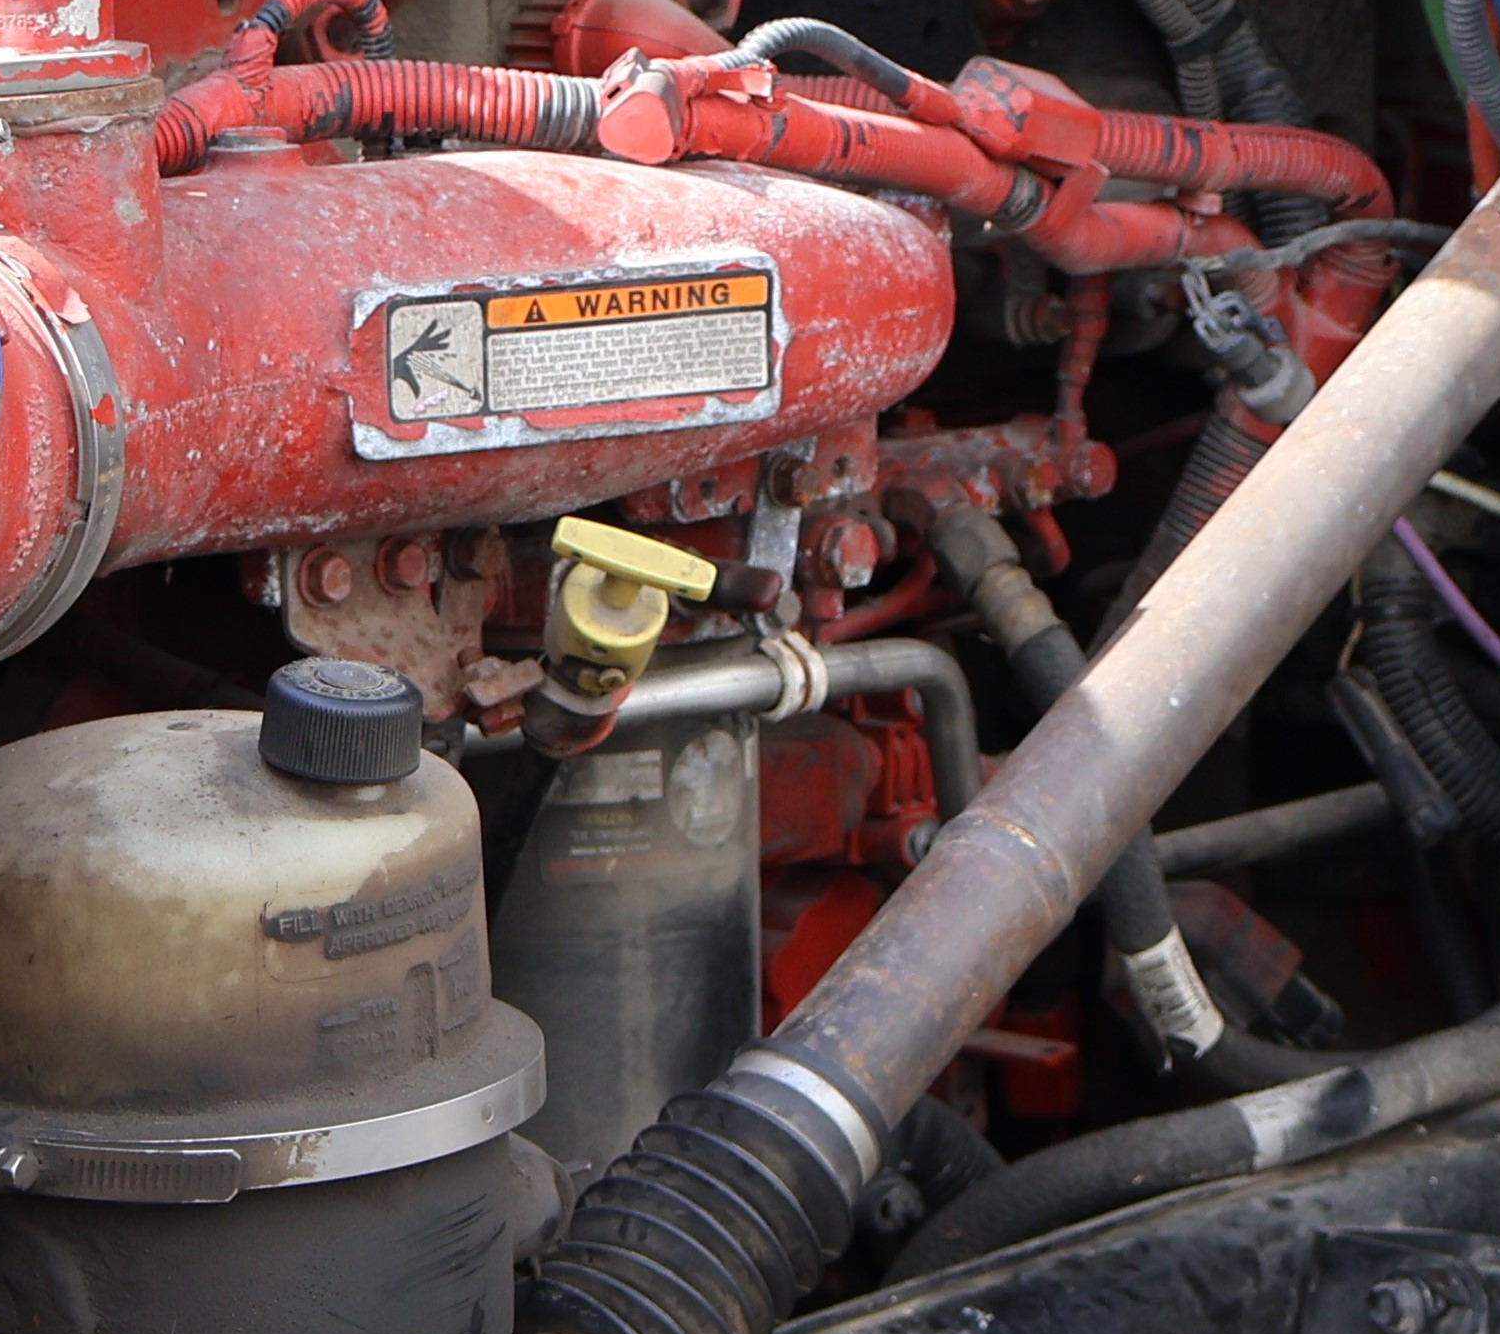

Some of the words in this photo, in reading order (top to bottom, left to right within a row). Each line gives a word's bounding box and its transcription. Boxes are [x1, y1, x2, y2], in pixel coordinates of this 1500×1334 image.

[576, 282, 731, 318] WARNING
[279, 913, 323, 936] FILL
[333, 902, 376, 927] WITH
